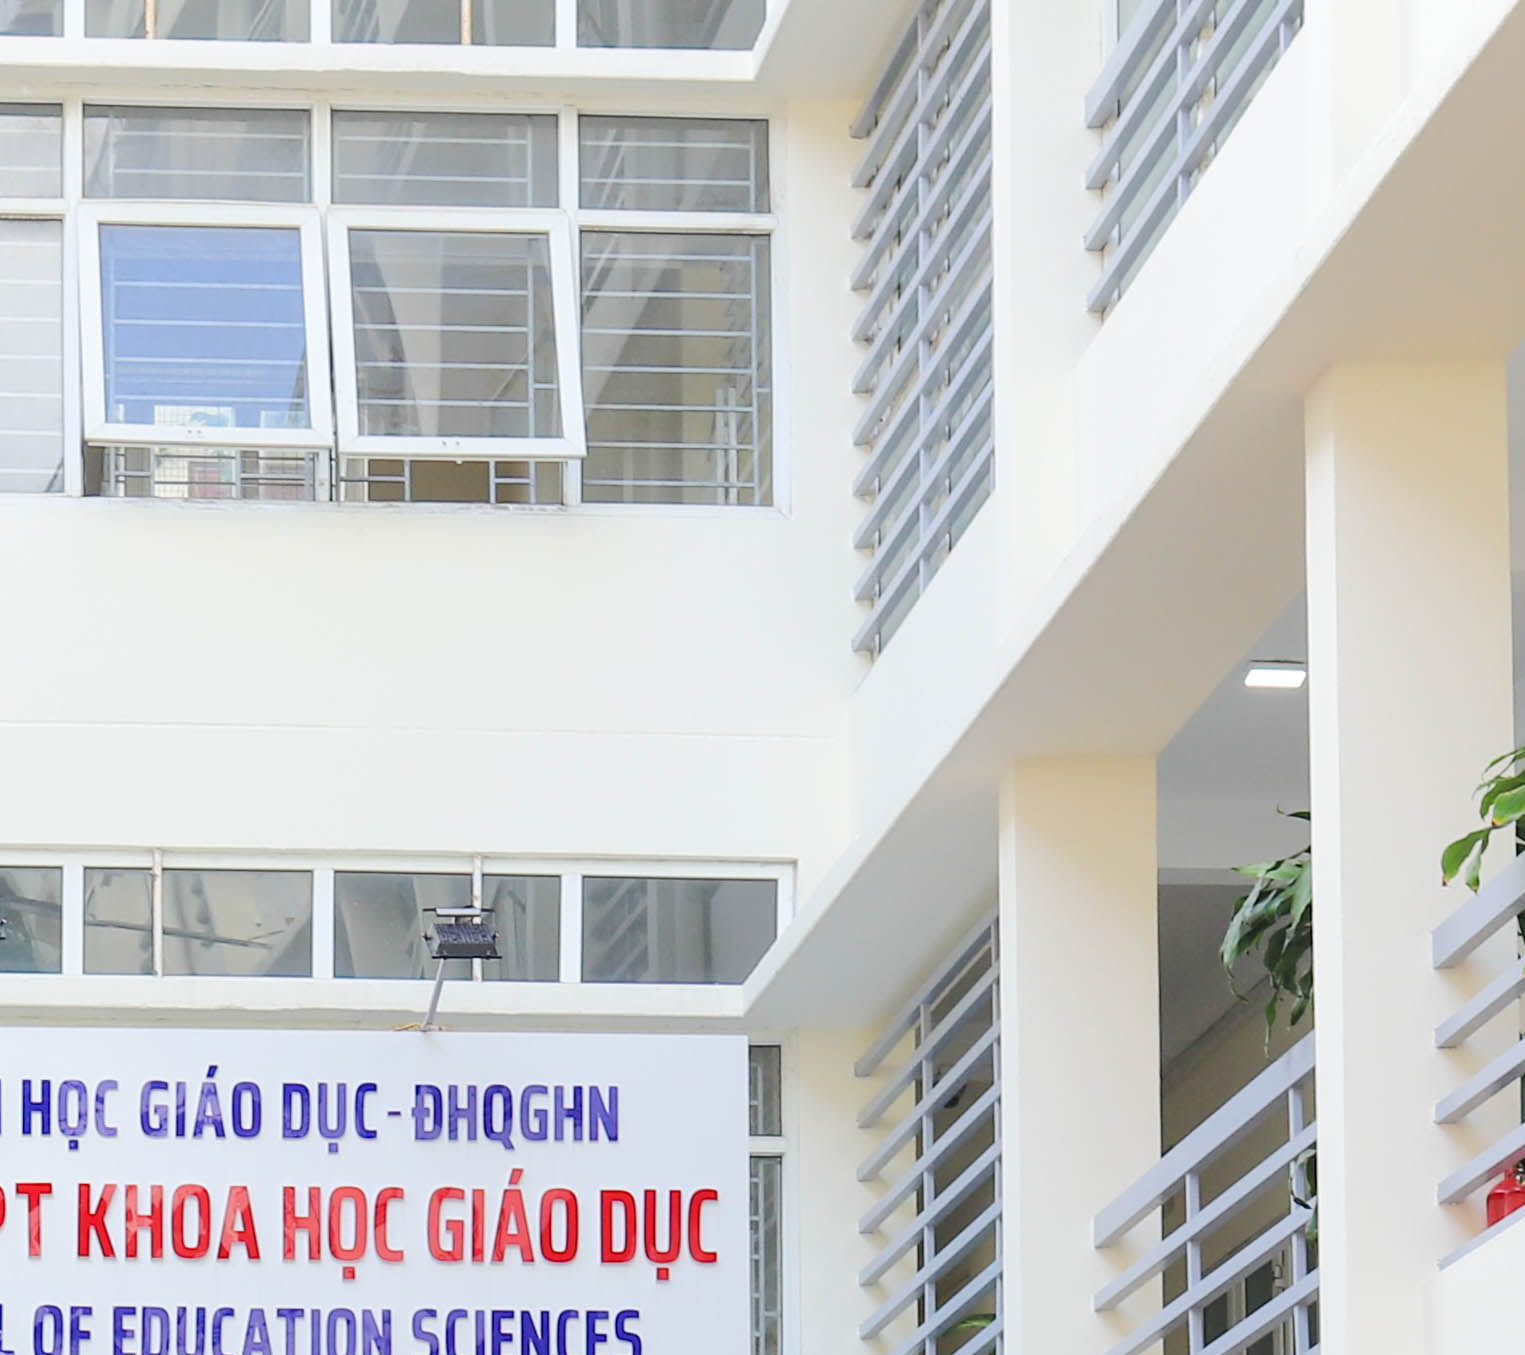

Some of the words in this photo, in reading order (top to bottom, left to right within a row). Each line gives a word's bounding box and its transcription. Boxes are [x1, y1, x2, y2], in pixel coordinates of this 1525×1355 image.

[21, 1079, 118, 1151] HỌC
[139, 1064, 262, 1139] GIÁO
[76, 1182, 261, 1261] KHOA
[282, 1186, 405, 1281] HỌC
[427, 1167, 580, 1264] GIÁO
[599, 1188, 719, 1281] DỤC
